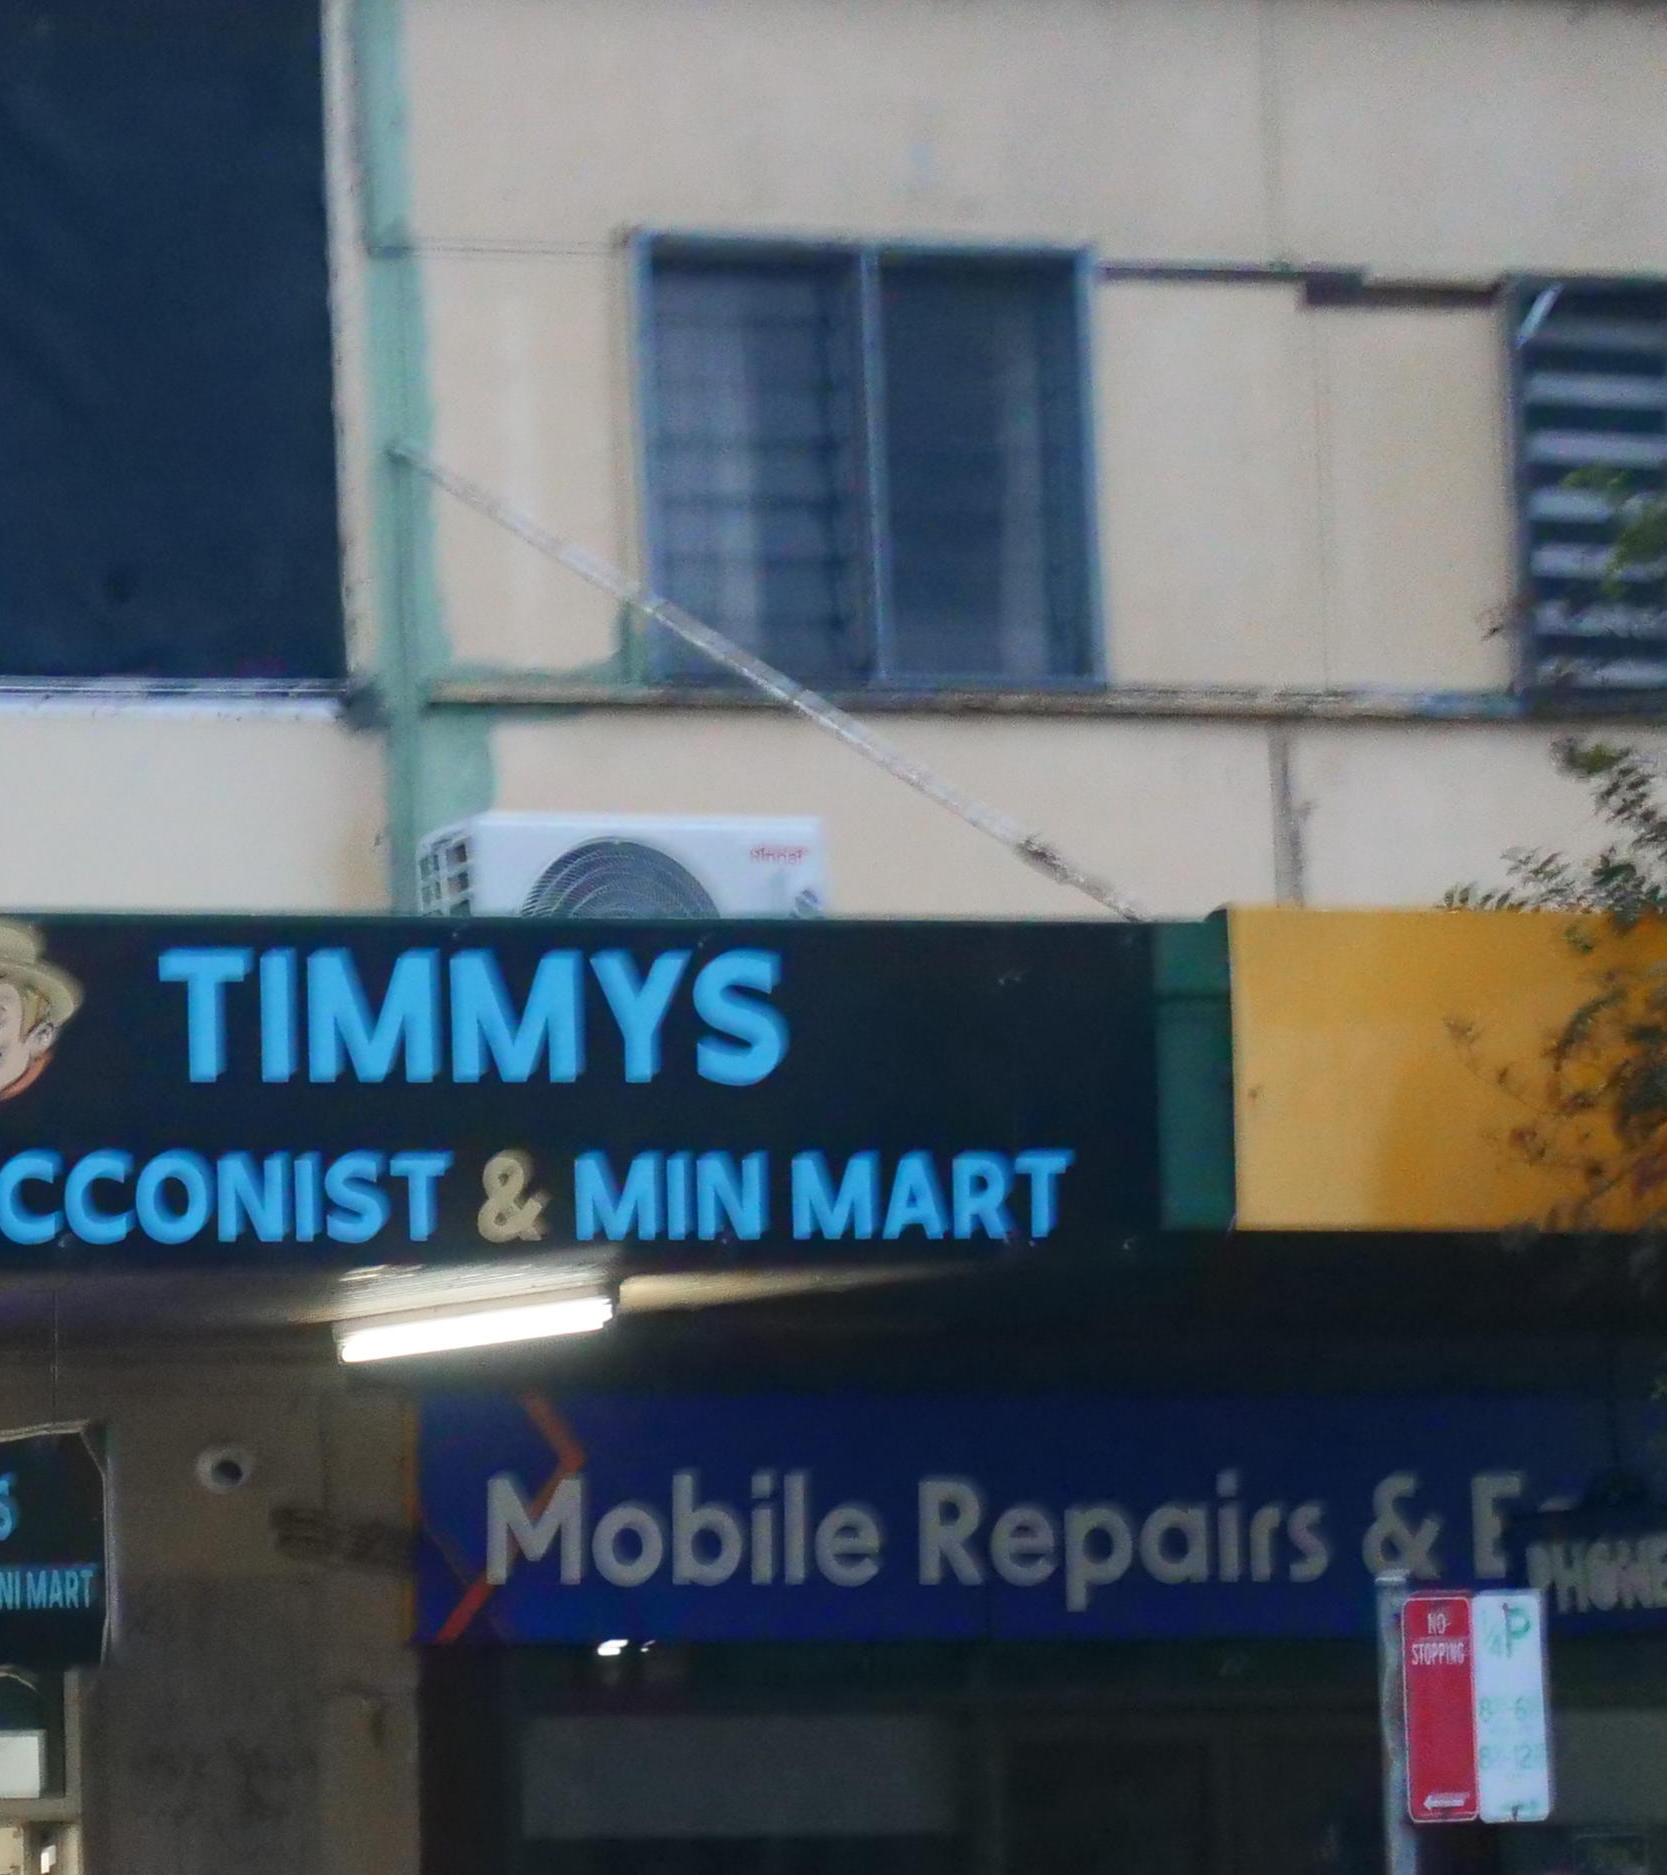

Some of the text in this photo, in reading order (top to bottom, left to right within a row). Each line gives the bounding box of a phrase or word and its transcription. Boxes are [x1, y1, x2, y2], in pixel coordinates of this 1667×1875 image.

[157, 945, 791, 1087] TIMMYS
[478, 1150, 550, 1243] &
[573, 1148, 766, 1243] MIN
[791, 1148, 1075, 1243] MART
[484, 1470, 884, 1588] Mobile
[916, 1470, 1331, 1612] Repairs
[1362, 1473, 1445, 1582] &
[25, 1562, 98, 1610] MART
[1411, 1640, 1466, 1666] STOPPING
[1427, 1612, 1451, 1635] NO
